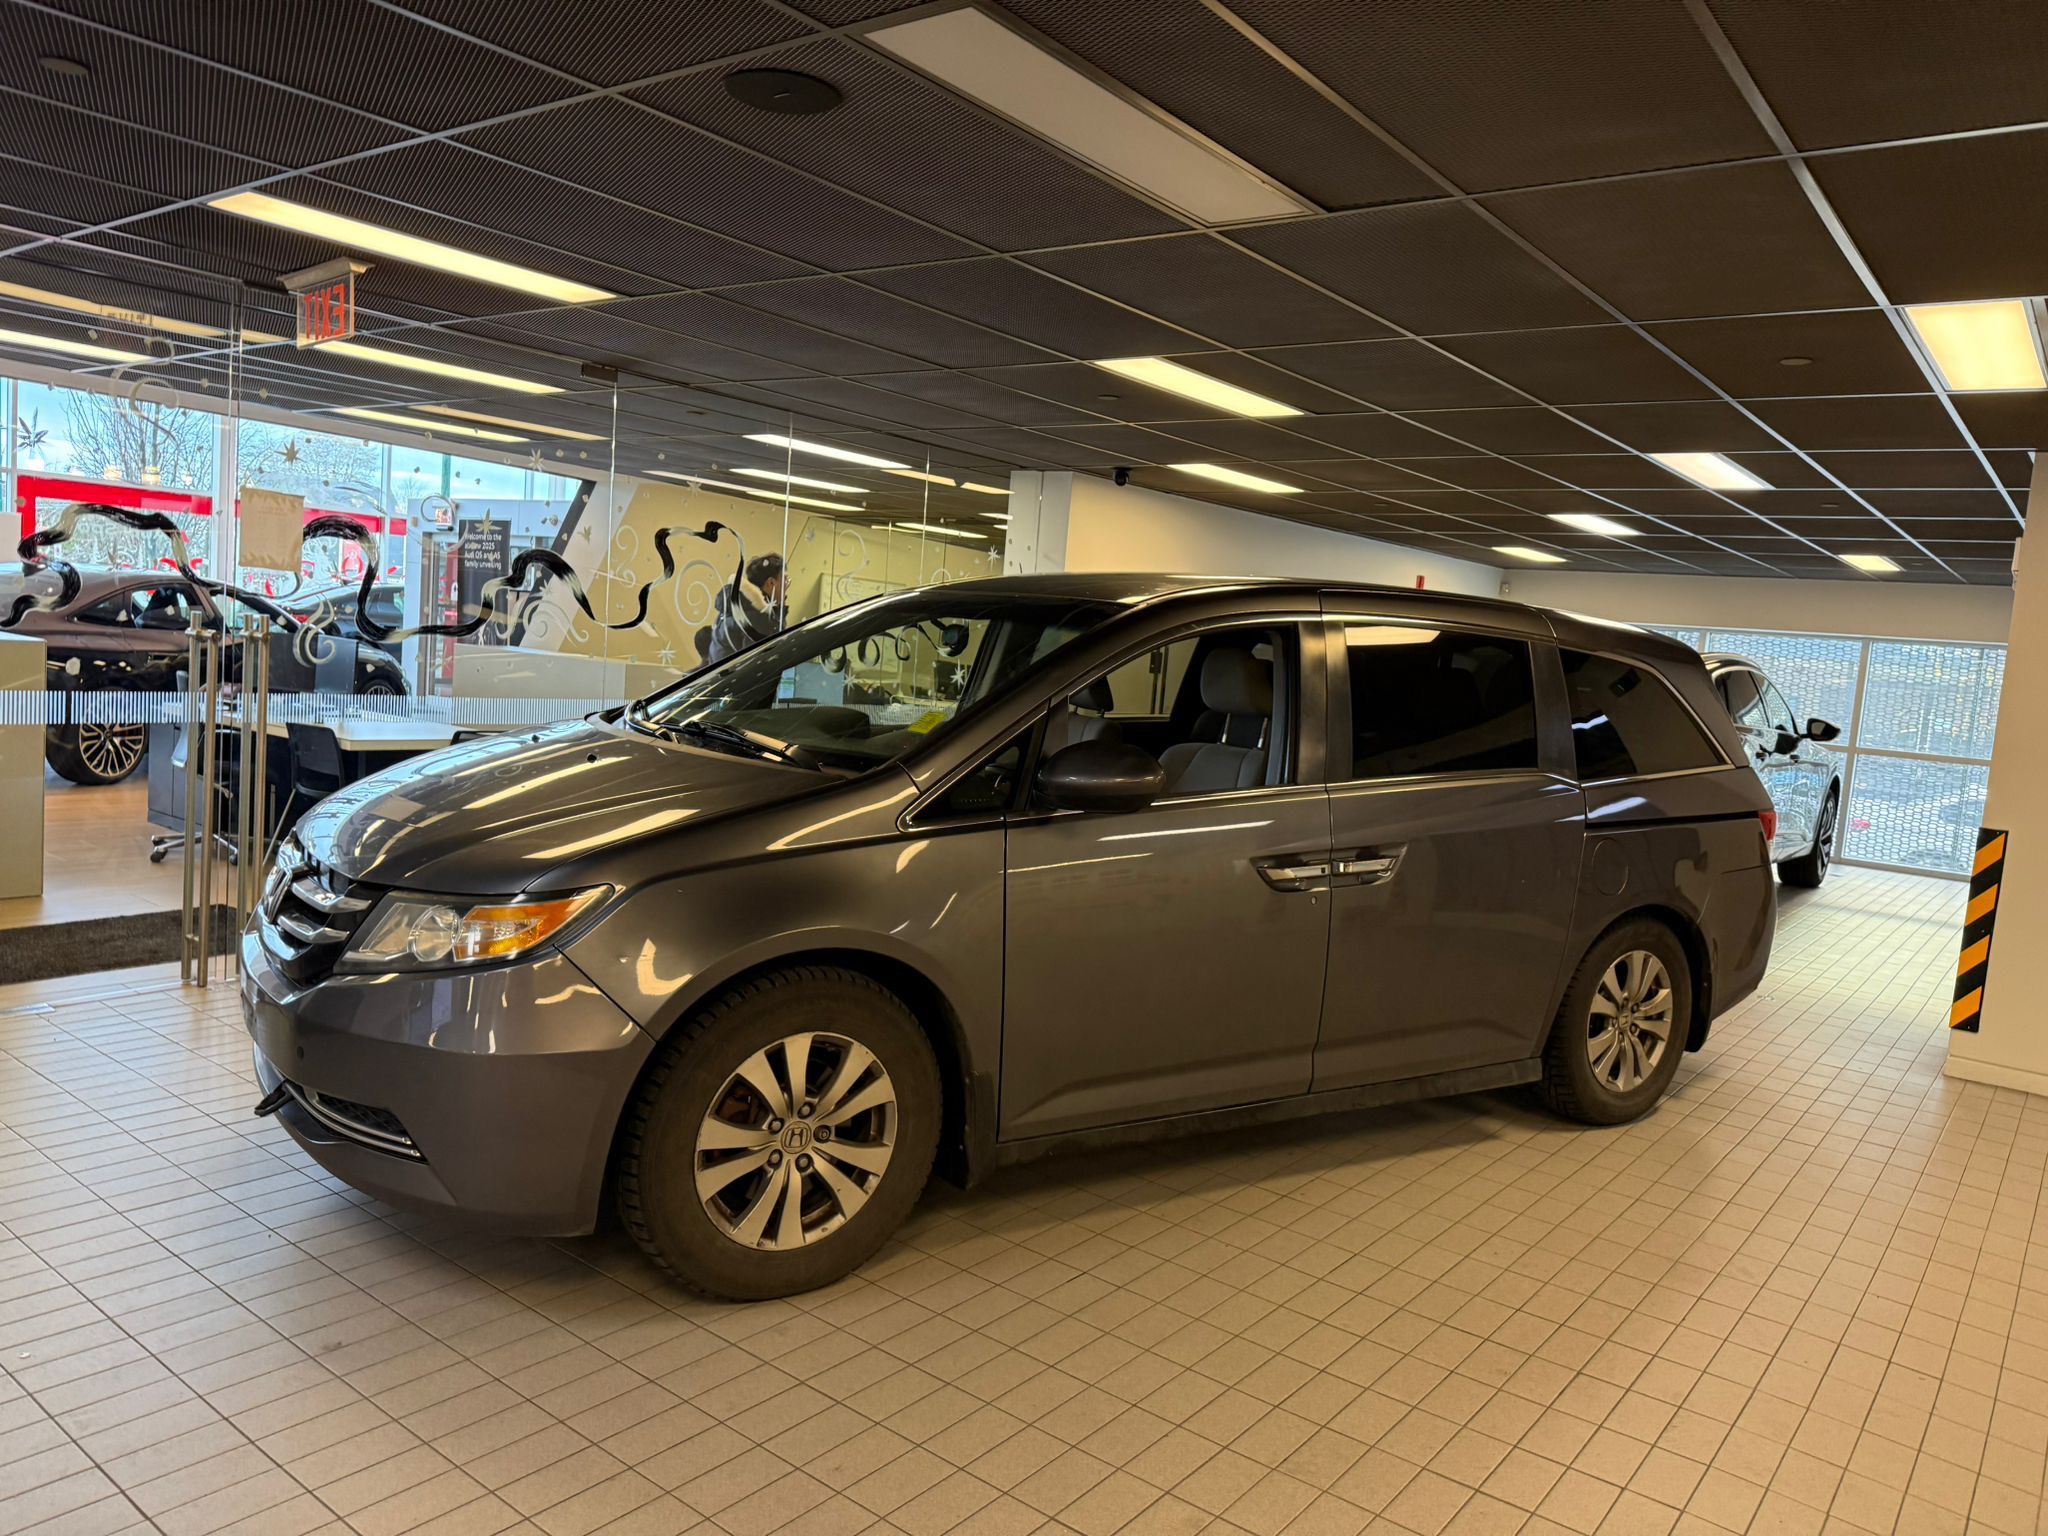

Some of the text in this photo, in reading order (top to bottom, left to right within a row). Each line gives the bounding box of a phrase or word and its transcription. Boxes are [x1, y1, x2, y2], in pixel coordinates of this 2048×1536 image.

[493, 533, 501, 541] the
[482, 542, 495, 550] 2025
[465, 560, 478, 569] family
